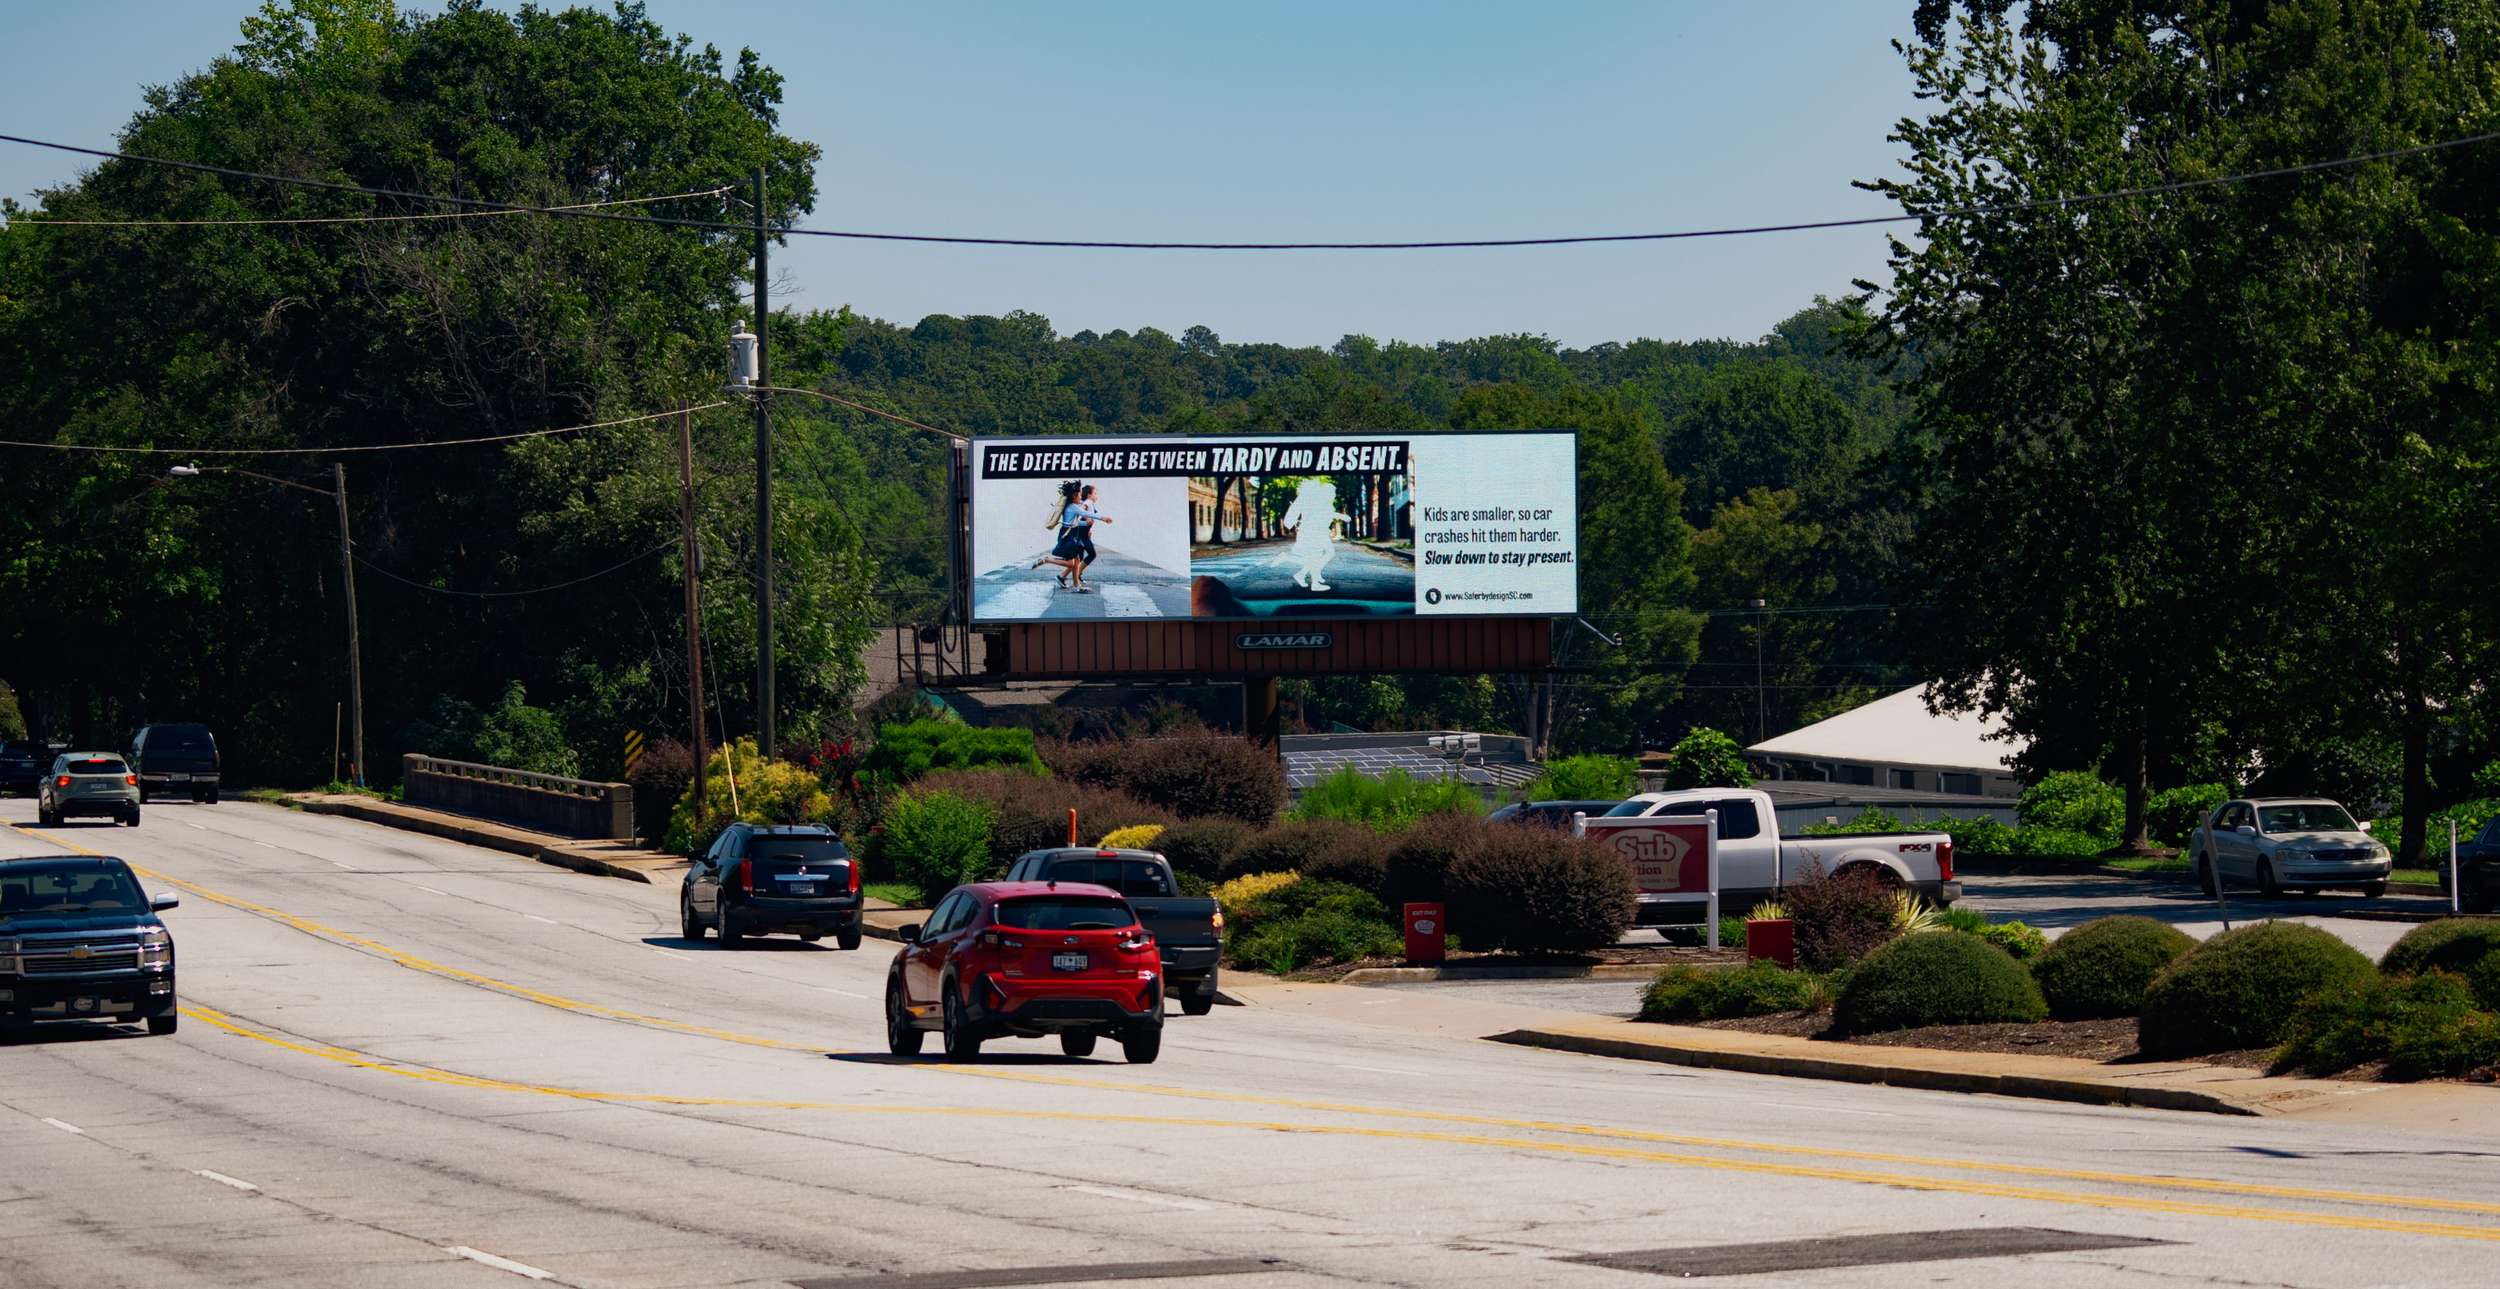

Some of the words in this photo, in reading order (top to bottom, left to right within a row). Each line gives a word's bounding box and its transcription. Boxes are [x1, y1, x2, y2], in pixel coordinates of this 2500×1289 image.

[989, 453, 1019, 471] THE
[1022, 452, 1124, 471] DIFFERENCE
[1127, 451, 1208, 470] BETWEEN
[1212, 447, 1278, 472] TARDY
[1278, 449, 1314, 469] AND
[1315, 445, 1402, 471] ABSENT.
[1424, 507, 1448, 521] Kids
[1450, 510, 1470, 521] are
[1472, 507, 1516, 522] smaller,
[1518, 510, 1531, 521] so
[1533, 509, 1552, 521] car
[1424, 528, 1469, 543] crashes
[1471, 528, 1486, 543] hit
[1489, 528, 1517, 542] them
[1520, 527, 1561, 542] harder.
[1425, 550, 1453, 565] Slow
[1455, 550, 1486, 564] down
[1488, 551, 1500, 564] to
[1501, 551, 1526, 567] stay
[1527, 551, 1574, 567] present.
[1445, 591, 1533, 602] www.SaferbydesignSC.com
[1243, 635, 1325, 646] LAMAR
[1616, 834, 1676, 862] Sub
[1899, 843, 1931, 852] FX4
